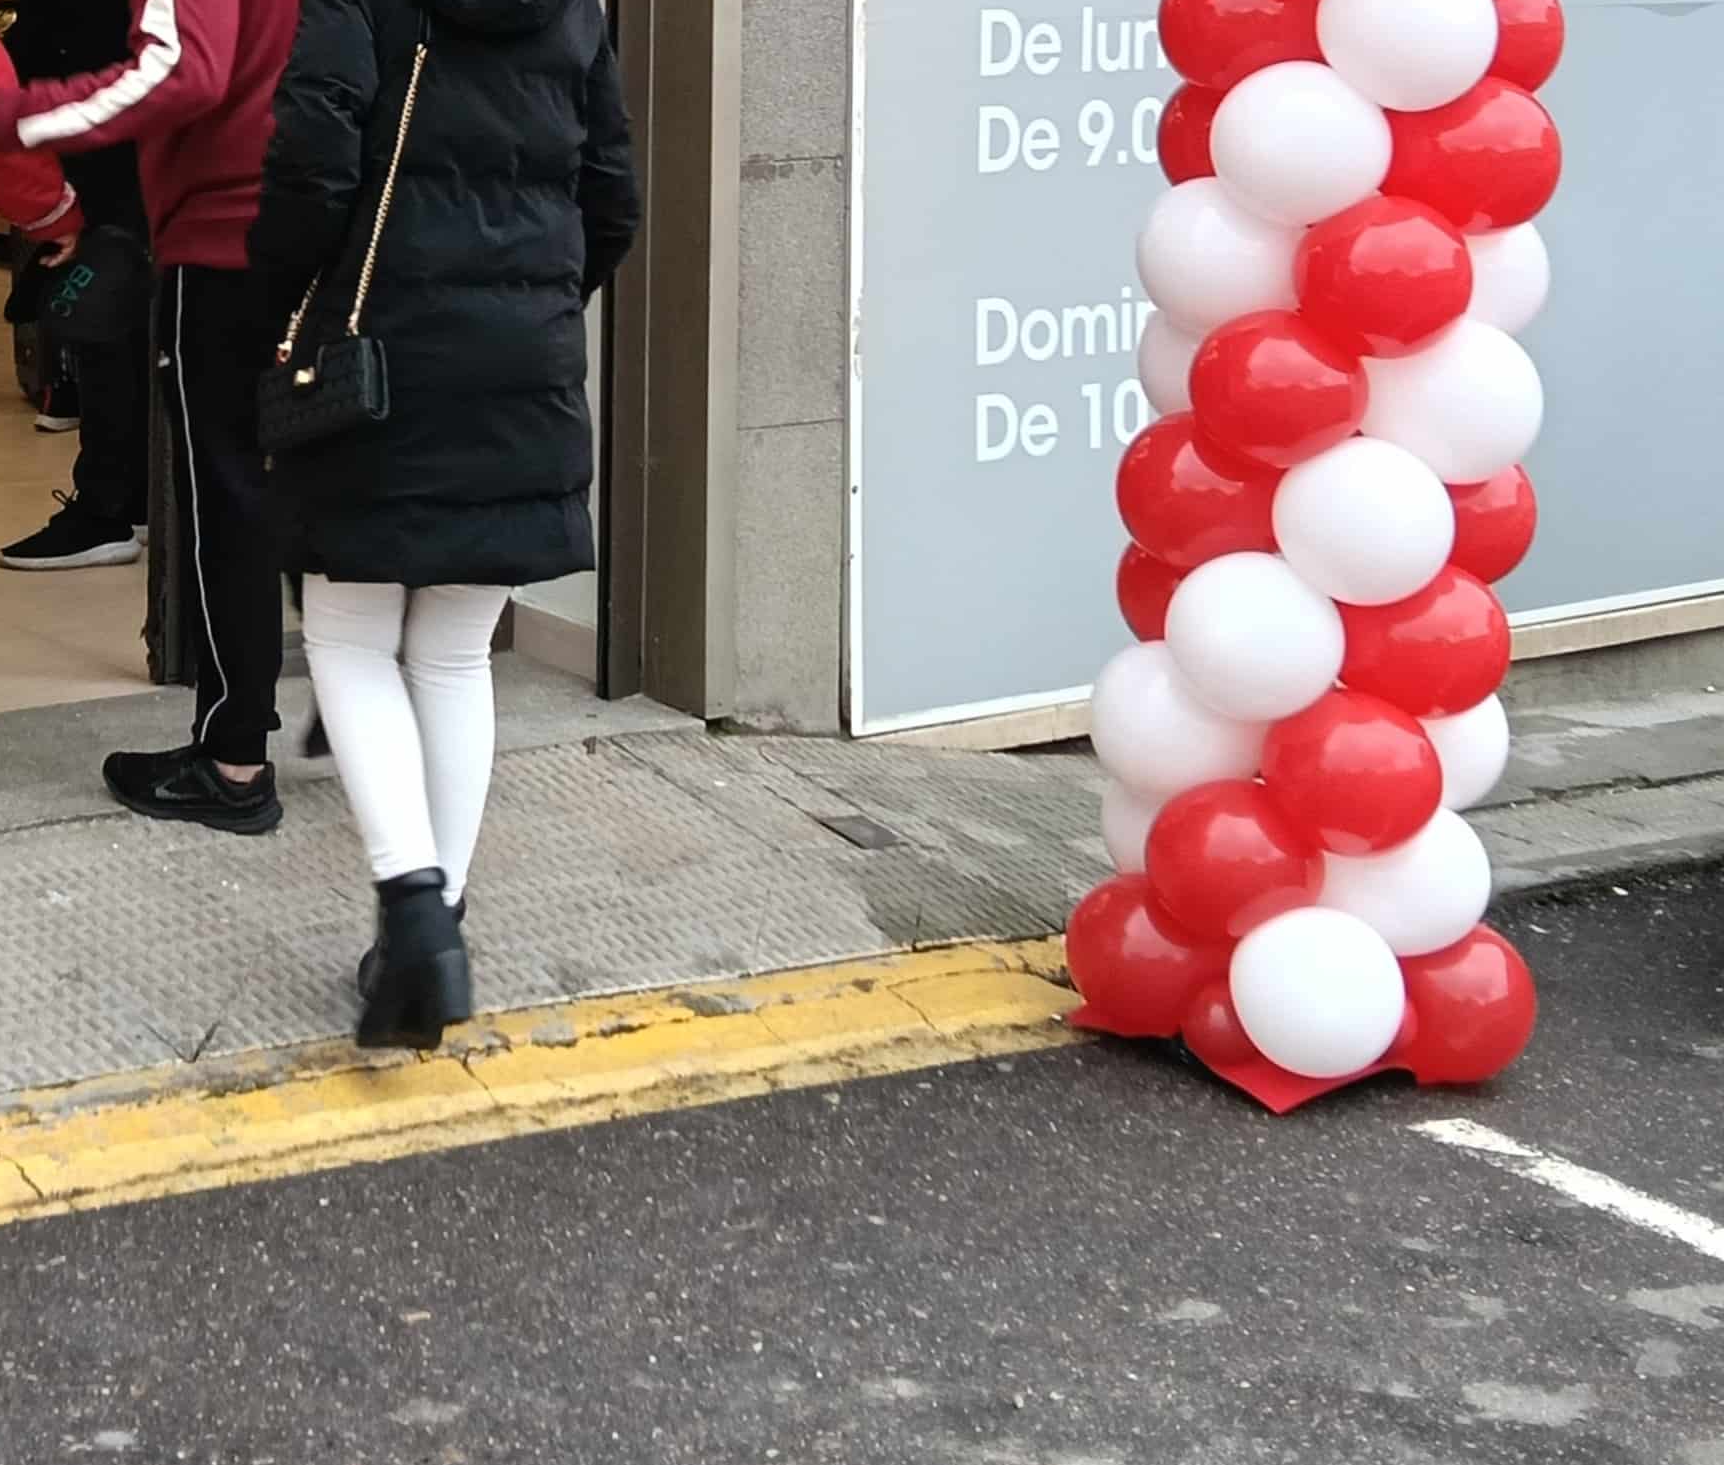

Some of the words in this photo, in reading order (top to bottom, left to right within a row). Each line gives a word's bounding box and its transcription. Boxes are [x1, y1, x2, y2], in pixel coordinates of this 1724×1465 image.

[979, 8, 1062, 77] De
[978, 105, 1061, 174] De
[977, 393, 1060, 463] De
